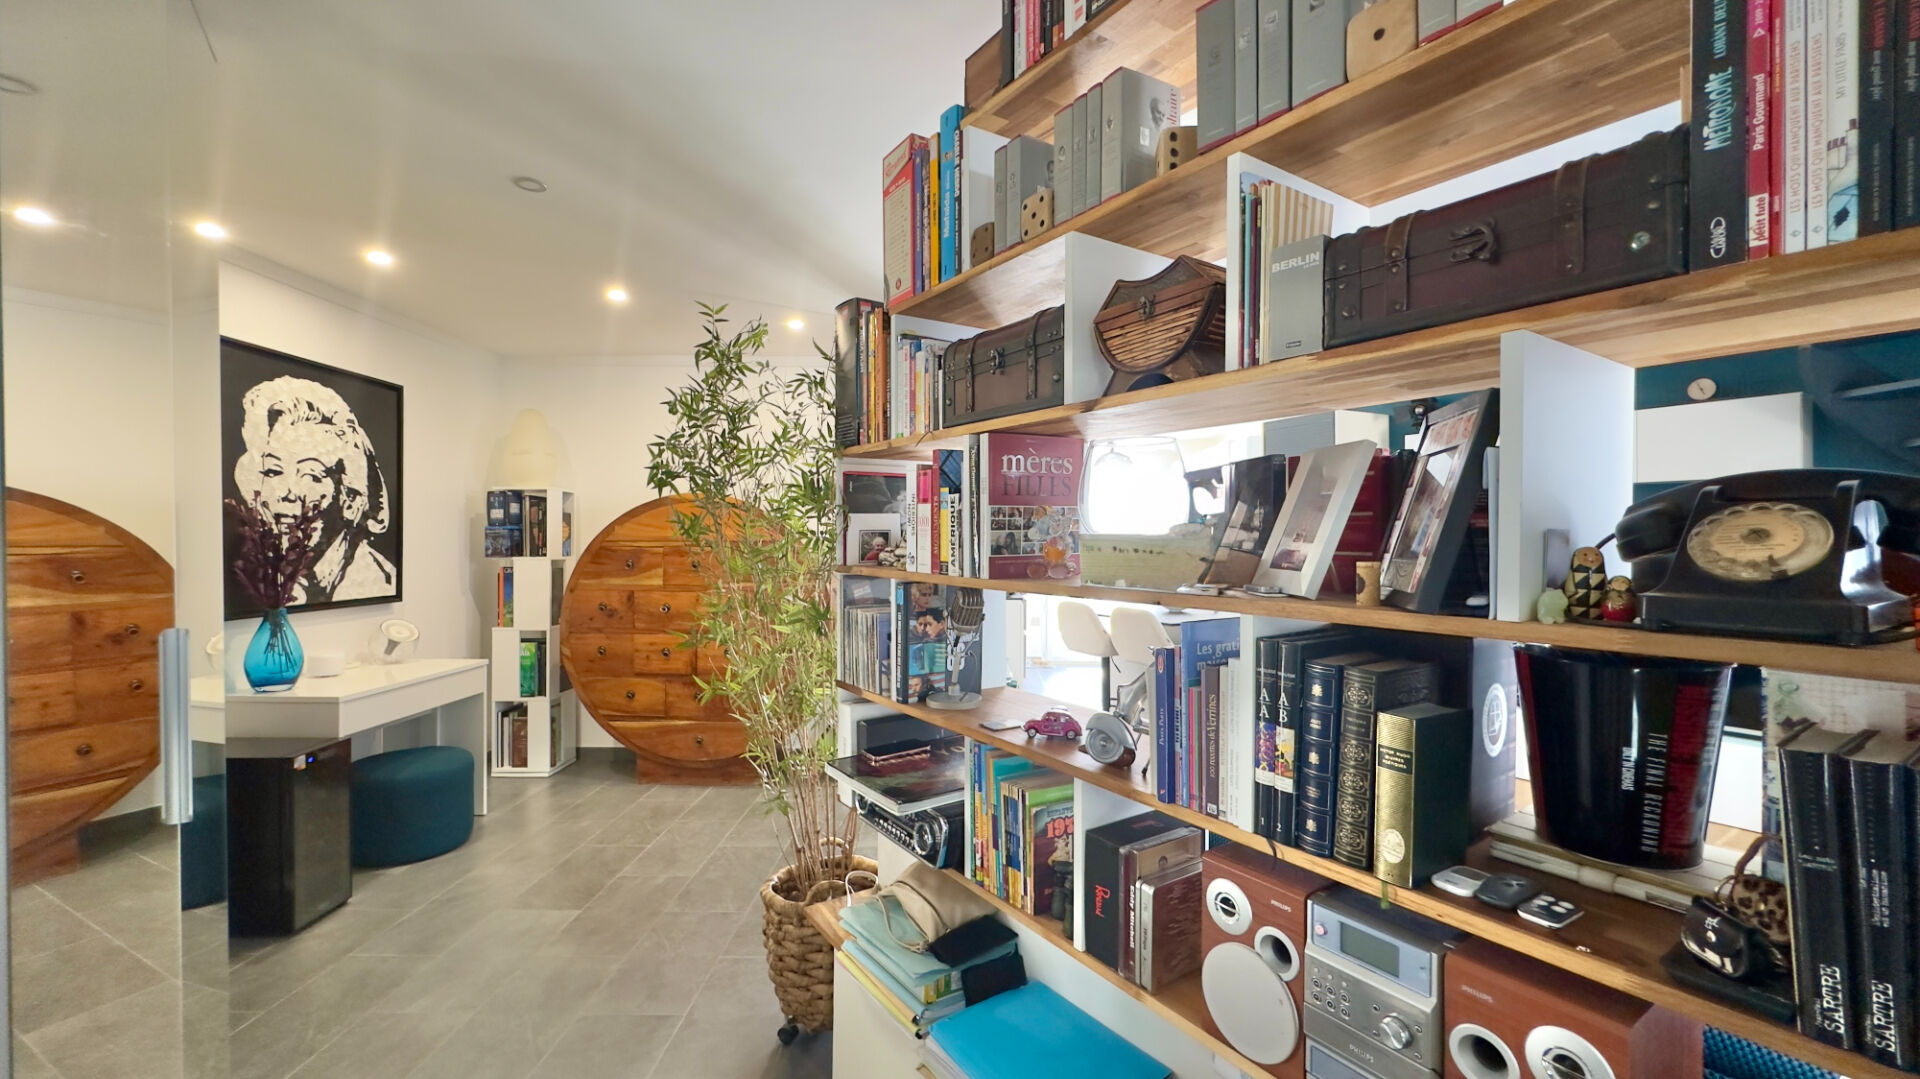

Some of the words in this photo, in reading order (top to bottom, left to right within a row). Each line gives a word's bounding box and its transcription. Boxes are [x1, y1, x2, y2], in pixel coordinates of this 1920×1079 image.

[1811, 32, 1823, 78] PARISIENS
[1834, 31, 1848, 58] PARIS
[1790, 40, 1801, 84] PARISIENS
[1834, 59, 1848, 84] LITTLE
[1752, 73, 1766, 123] Gourmand
[1790, 85, 1801, 103] AUX
[1811, 79, 1823, 96] AUX
[1790, 104, 1801, 152] MANQUENT
[1811, 98, 1823, 146] MANQUENT
[1752, 125, 1766, 151] Paris
[1790, 153, 1801, 172] QUI
[1811, 147, 1823, 166] QUI
[1790, 172, 1801, 197] MOTS
[1811, 167, 1823, 192] MOTS
[1790, 198, 1801, 213] LES
[1811, 193, 1823, 208] LES
[1271, 251, 1320, 273] BERLIN
[1001, 447, 1073, 475] mères
[1001, 476, 1071, 497] FILLES
[1196, 642, 1213, 655] Les
[1259, 688, 1270, 702] A
[1279, 693, 1289, 706] A
[1206, 694, 1217, 730] Verrines
[1259, 704, 1270, 719] A
[1279, 709, 1288, 723] B
[1647, 732, 1668, 753] THE
[1621, 768, 1635, 791] CINEMAS
[1644, 757, 1667, 788] FINAL
[1640, 793, 1663, 853] RECKONING
[1094, 884, 1112, 918] Renaud
[1270, 899, 1293, 913] PHILIPS
[1459, 983, 1494, 1004] PHILIPS
[1819, 964, 1845, 1034] SARTRE
[1871, 979, 1896, 1052] SARTRE
[1349, 1043, 1374, 1064] PHILIPS
